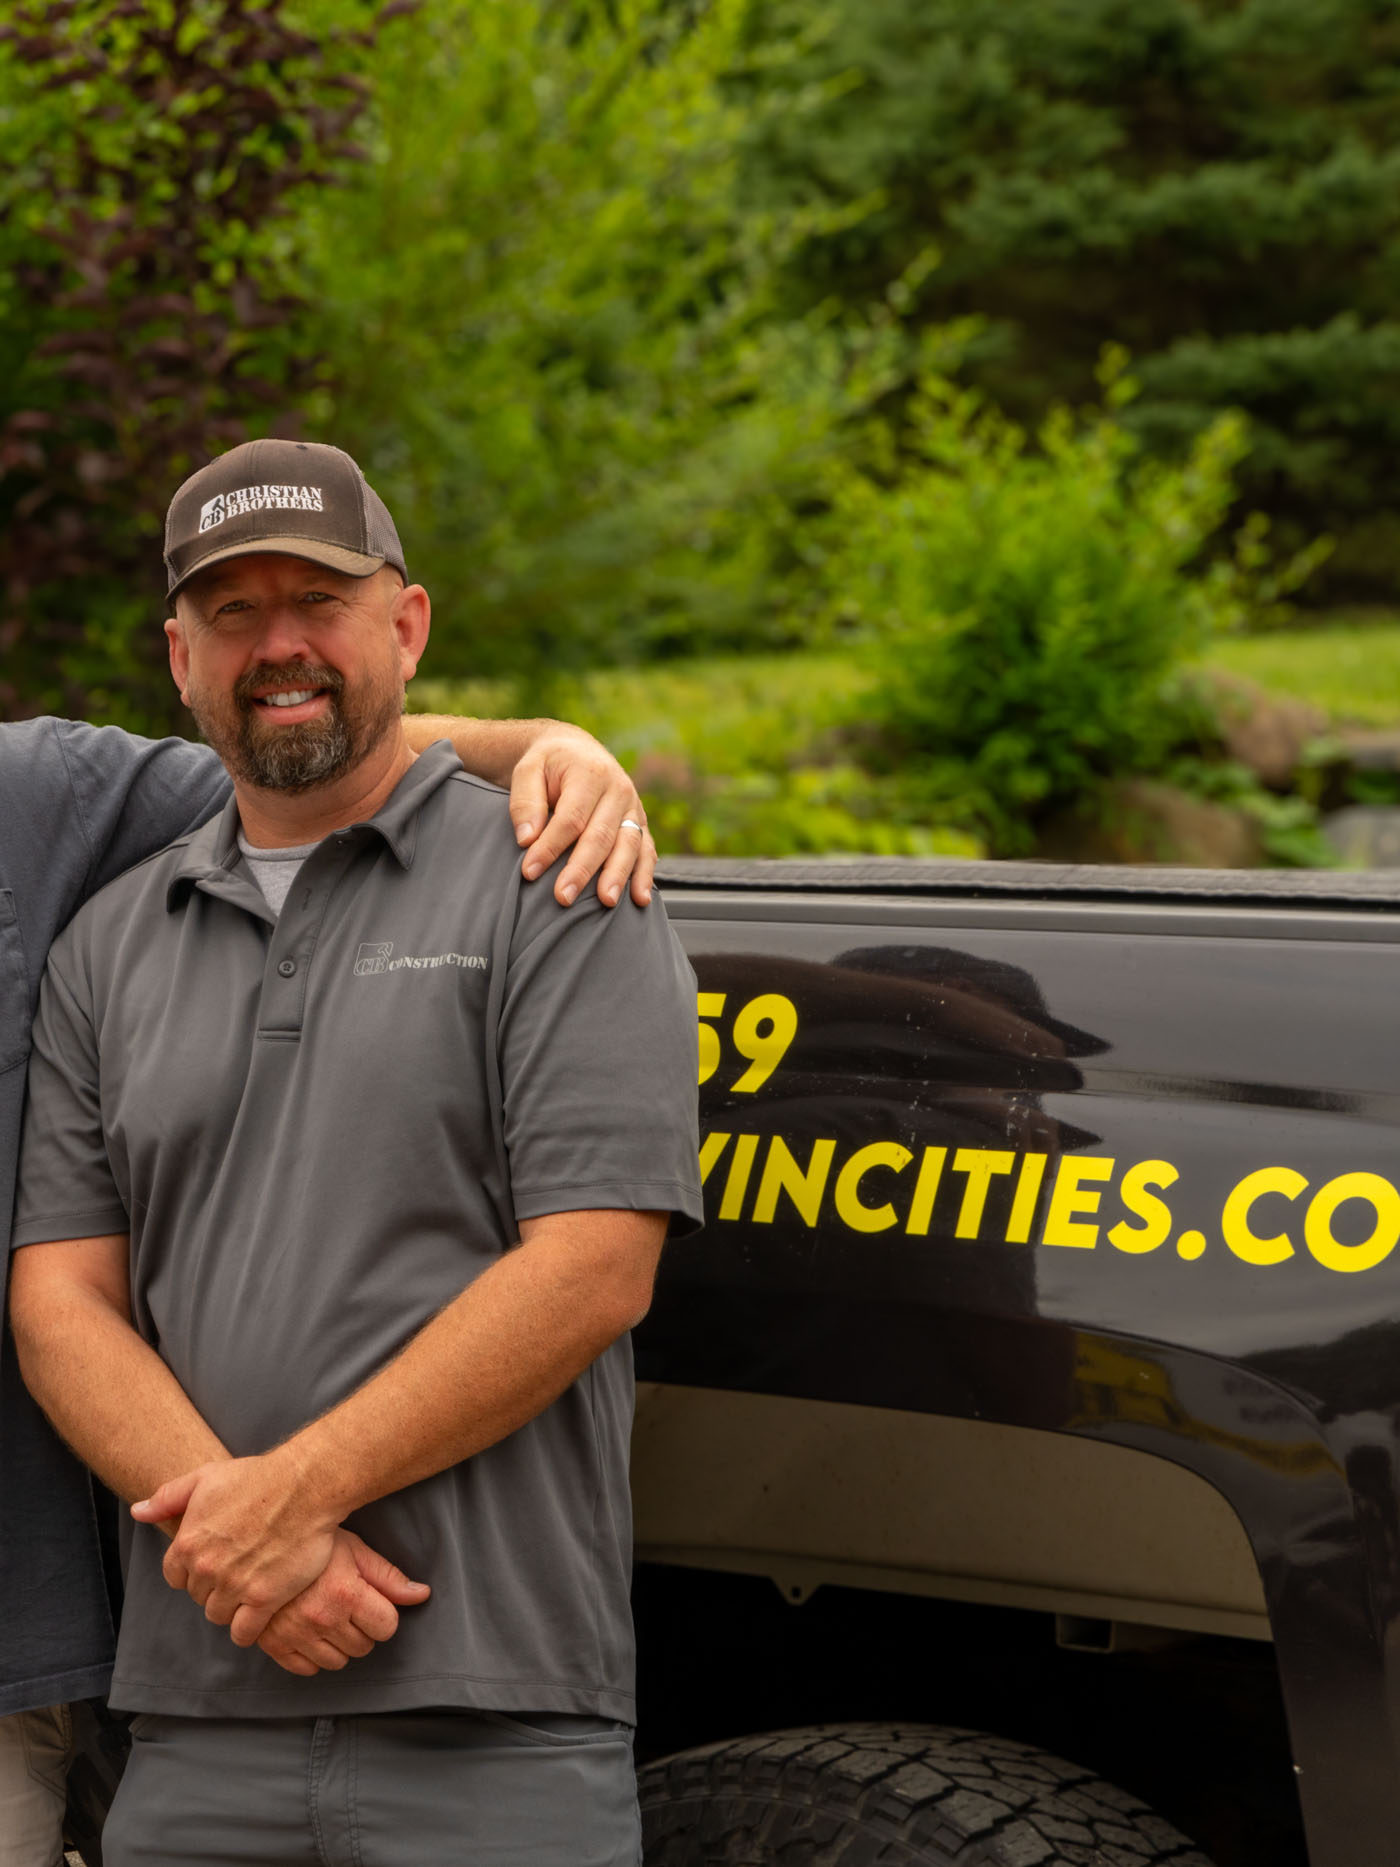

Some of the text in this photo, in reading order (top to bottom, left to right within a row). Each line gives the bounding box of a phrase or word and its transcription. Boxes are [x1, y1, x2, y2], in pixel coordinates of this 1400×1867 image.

[226, 485, 322, 505] CHRISTIAN
[226, 497, 323, 519] BROTHERS
[201, 510, 221, 531] CB
[389, 953, 488, 970] CONSTRUCTION
[699, 1132, 1400, 1273] INCITIES.CO
